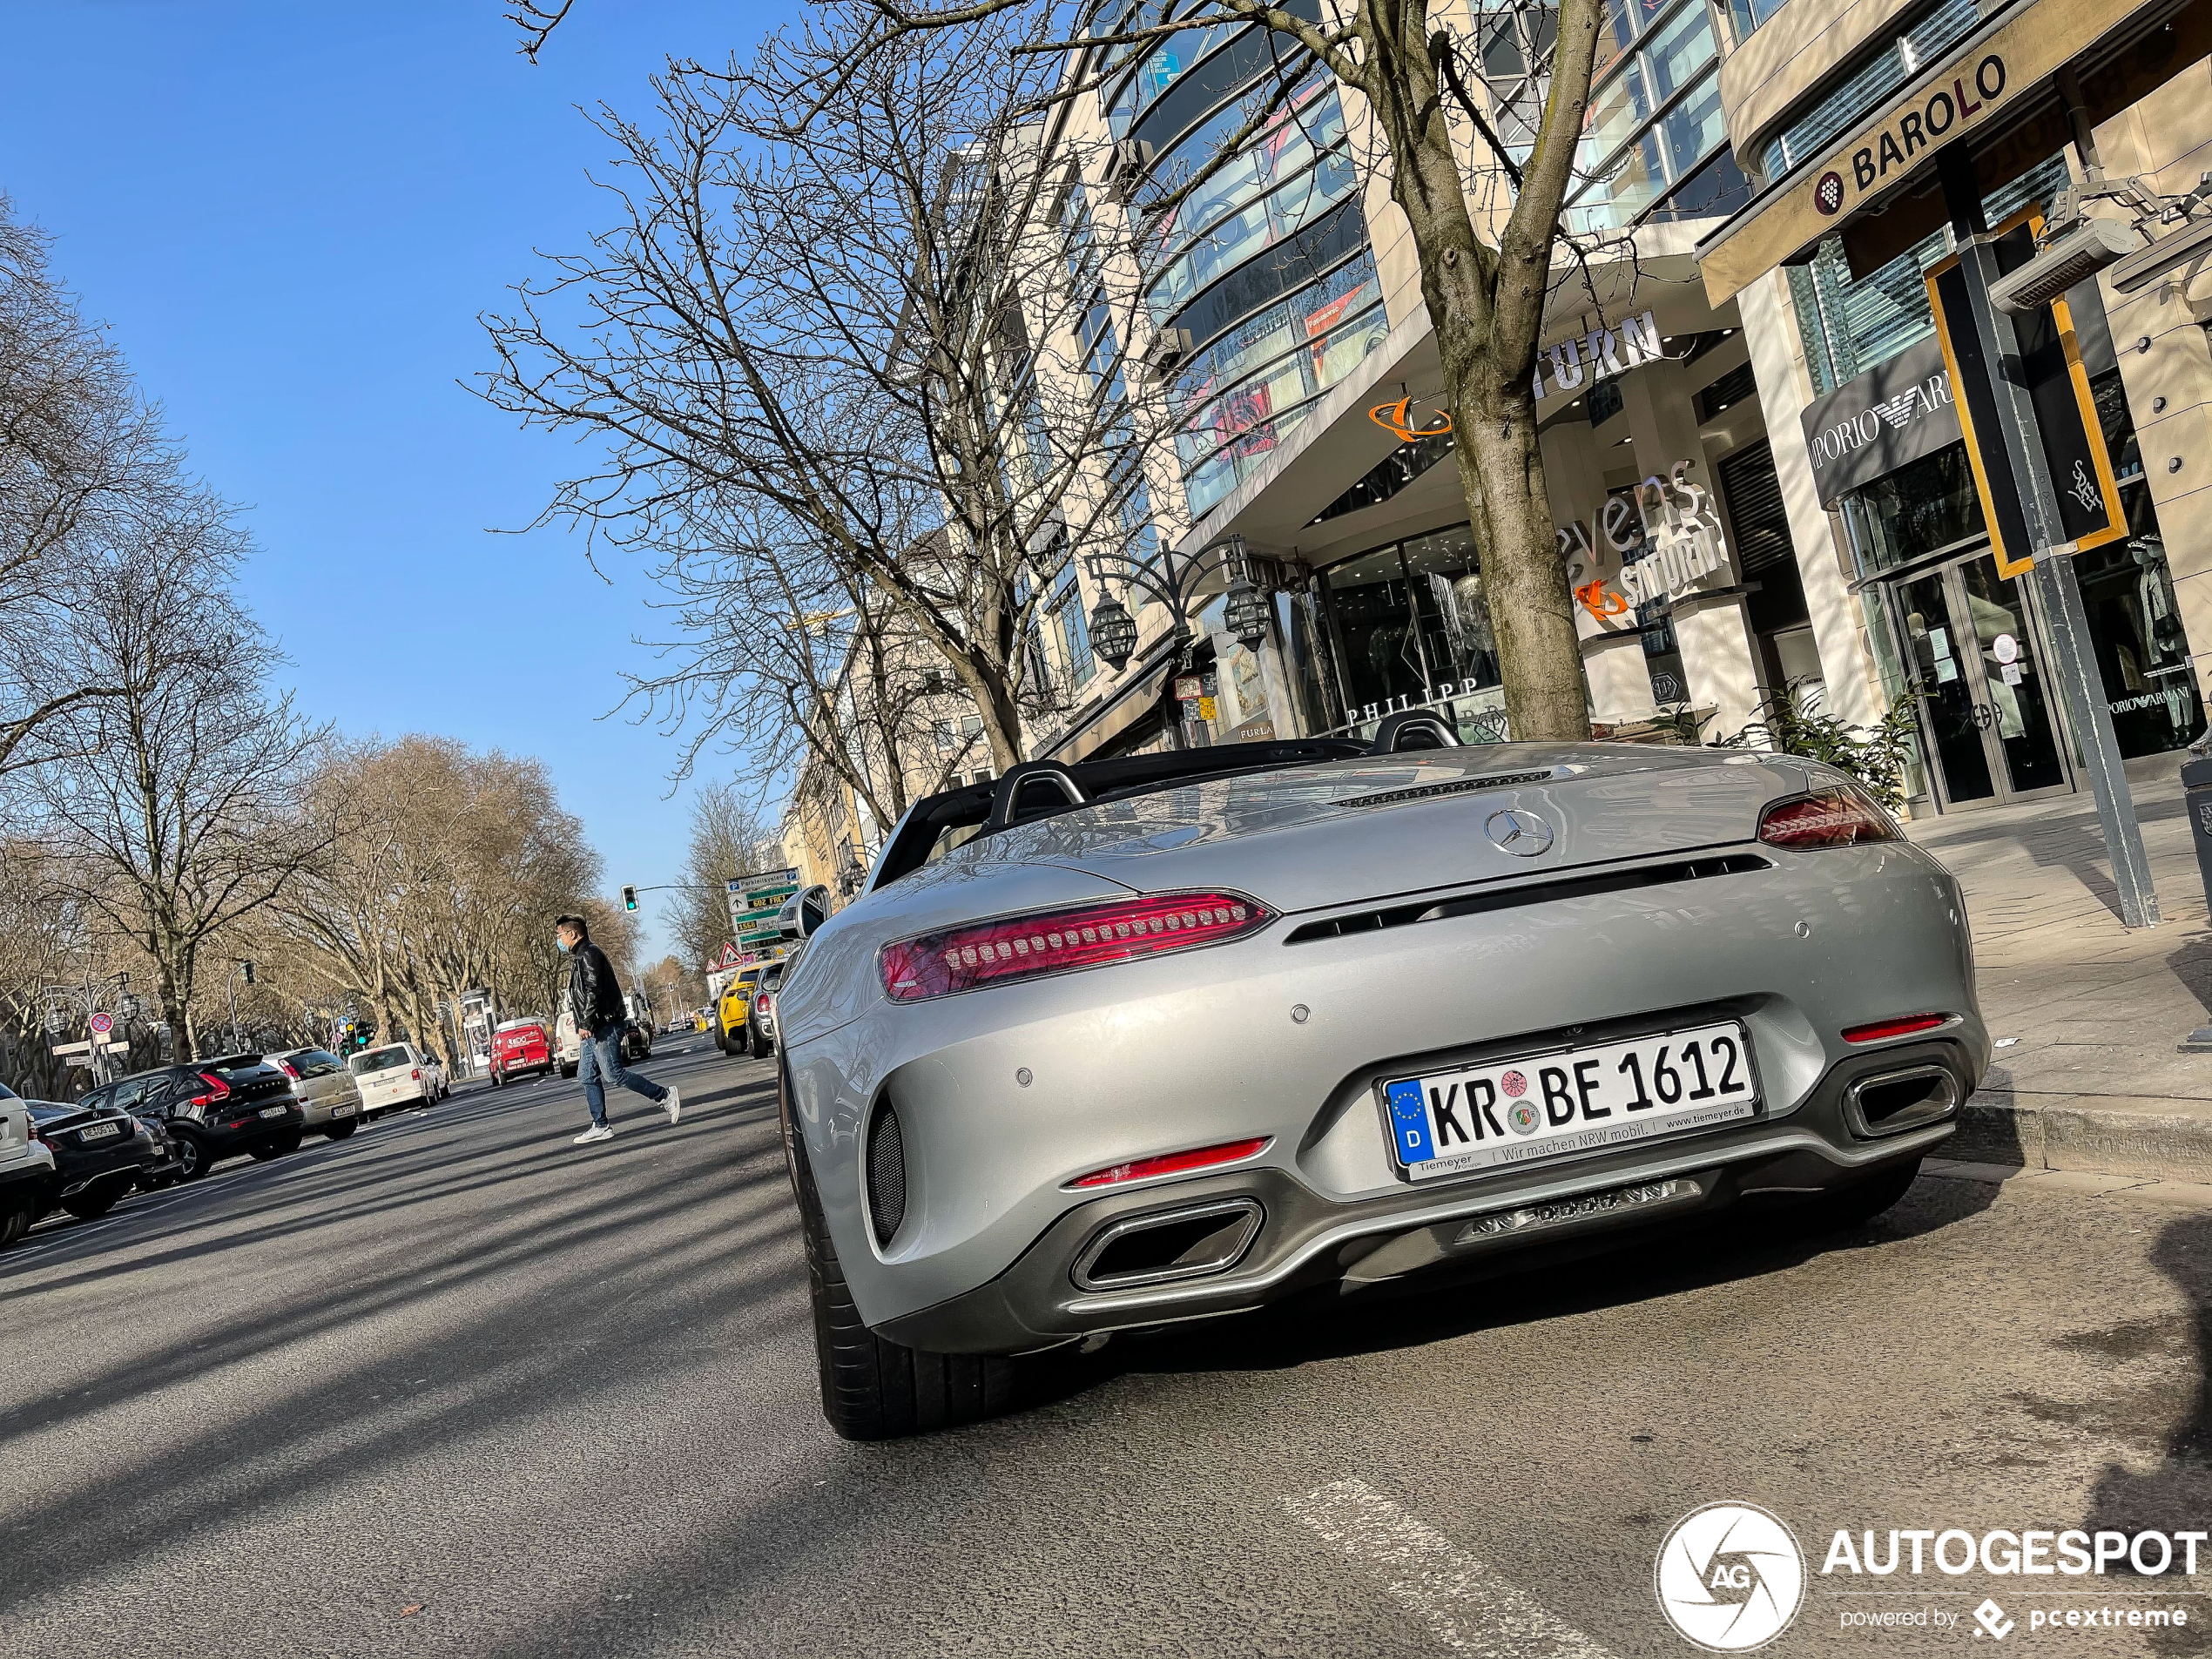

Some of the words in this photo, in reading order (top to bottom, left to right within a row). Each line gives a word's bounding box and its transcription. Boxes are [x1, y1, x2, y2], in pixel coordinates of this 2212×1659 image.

[1851, 54, 2006, 192] BAROLO
[1308, 306, 1339, 327] Panasonic
[1620, 525, 1721, 609] SATURN
[1346, 677, 1478, 727] PHILIPP
[2149, 686, 2190, 706] ARMANI
[1240, 725, 1273, 739] FURLA
[1428, 1077, 1505, 1147] KR
[1538, 1059, 1612, 1128] BE
[1617, 1035, 1745, 1113] 1612
[1406, 1130, 1421, 1148] D
[1418, 1155, 1472, 1171] Tiemeyer
[1502, 1147, 1524, 1162] Wir
[1527, 1138, 1576, 1157] machen
[1579, 1130, 1608, 1147] NRW
[1610, 1122, 1649, 1141] mobil.
[1666, 1105, 1745, 1128] www.tiemeyer.de
